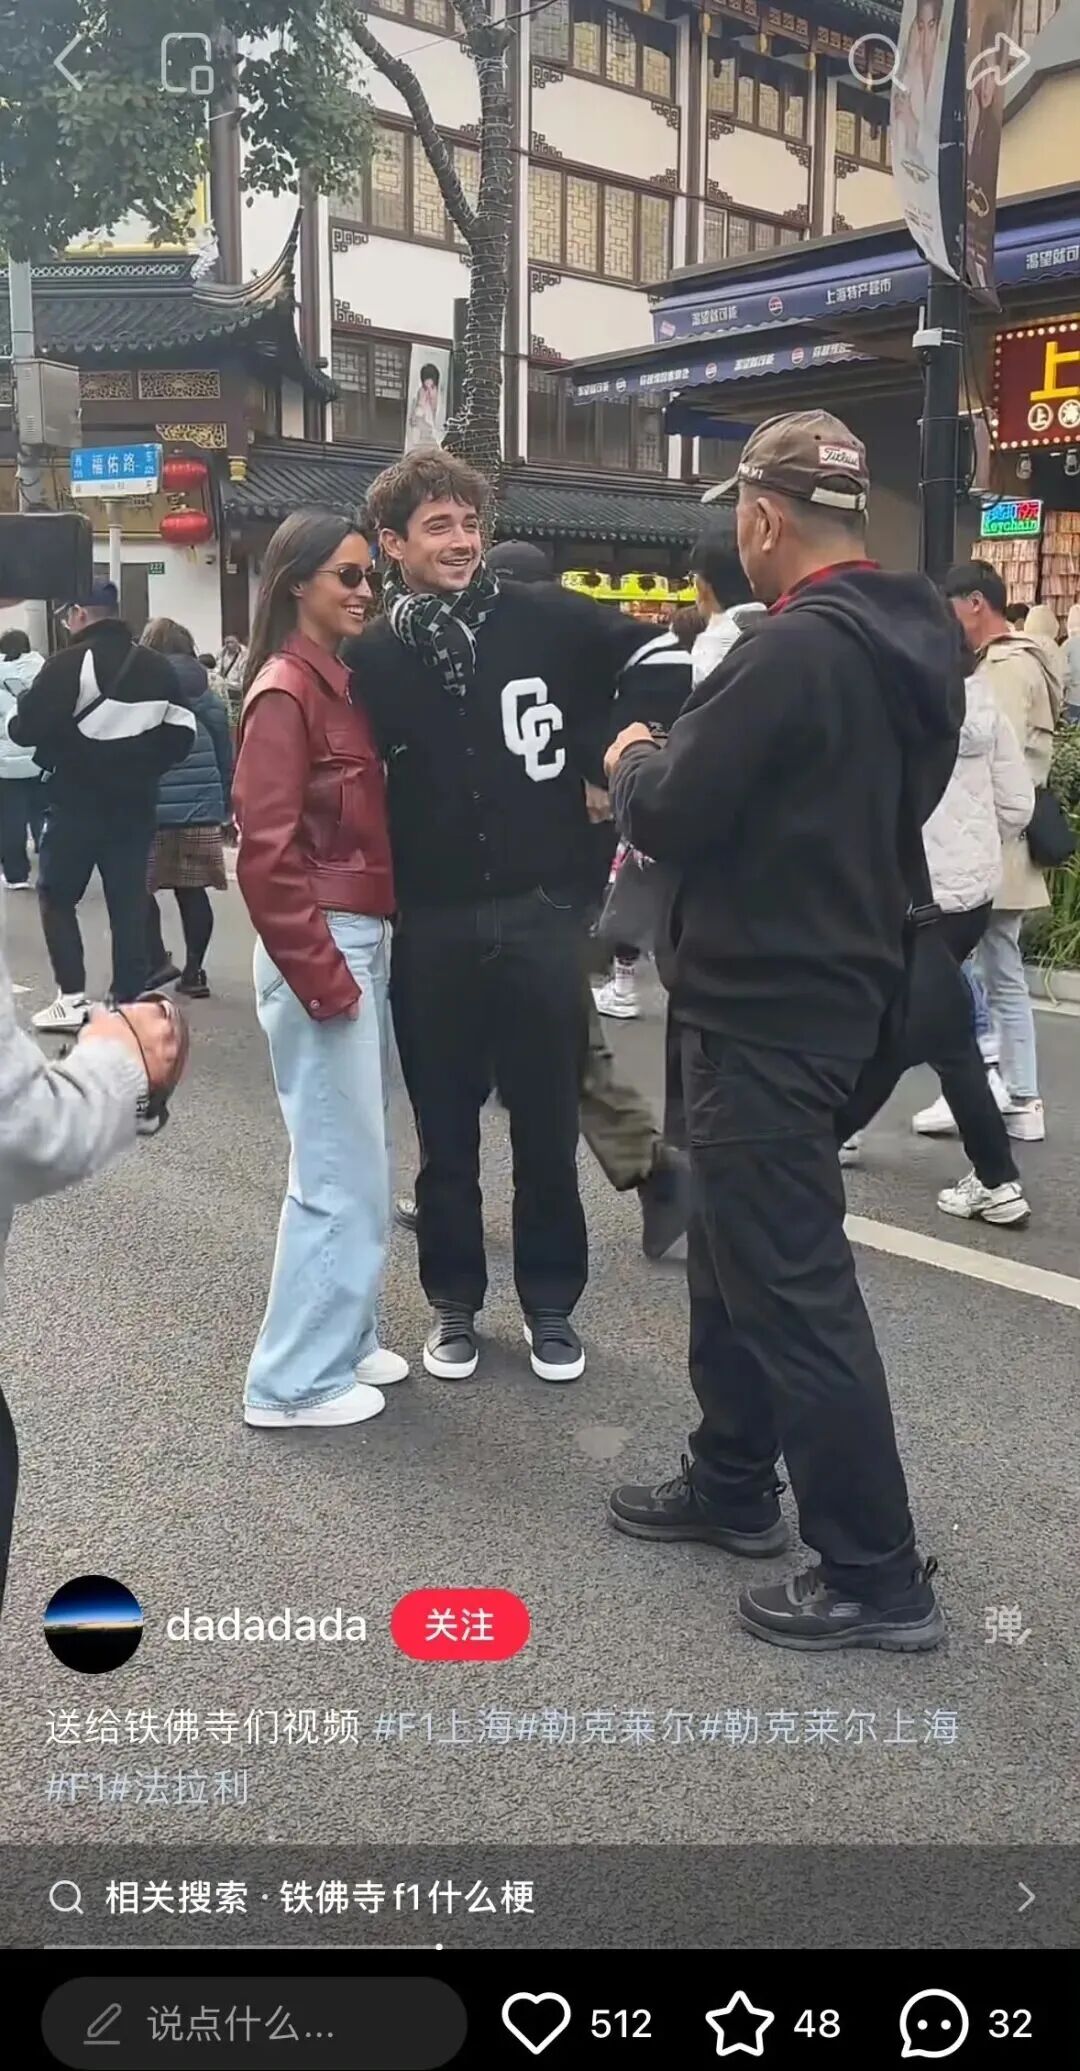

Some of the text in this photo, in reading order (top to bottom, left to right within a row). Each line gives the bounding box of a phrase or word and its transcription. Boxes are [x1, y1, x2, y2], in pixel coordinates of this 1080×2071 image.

[825, 278, 892, 305] 上海特产超市
[91, 452, 136, 475] 福佑路
